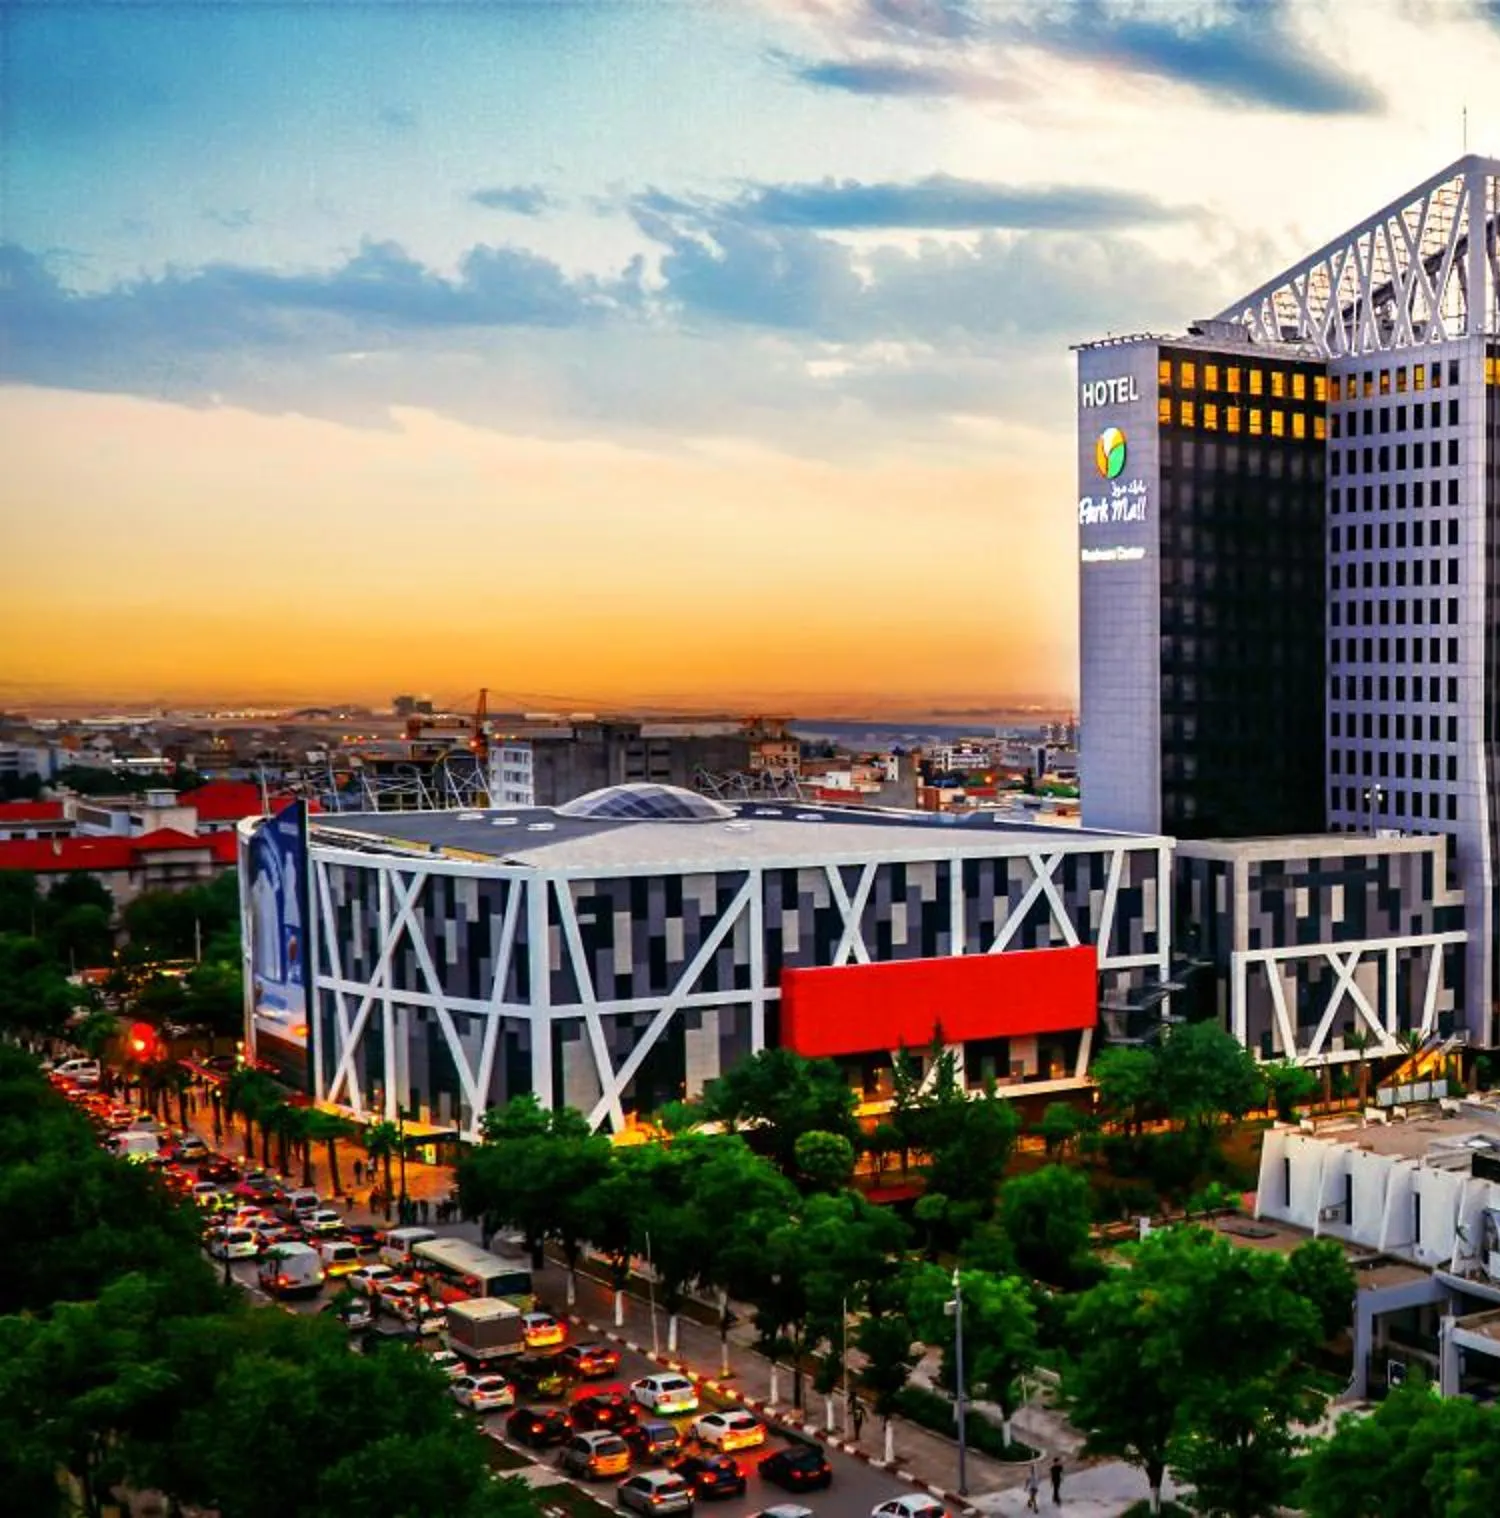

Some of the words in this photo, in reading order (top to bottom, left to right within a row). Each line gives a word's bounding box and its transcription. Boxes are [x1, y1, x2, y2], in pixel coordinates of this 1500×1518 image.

[1083, 375, 1139, 408] HOTEL
[1079, 496, 1109, 524] Park
[1111, 495, 1147, 521] Mall
